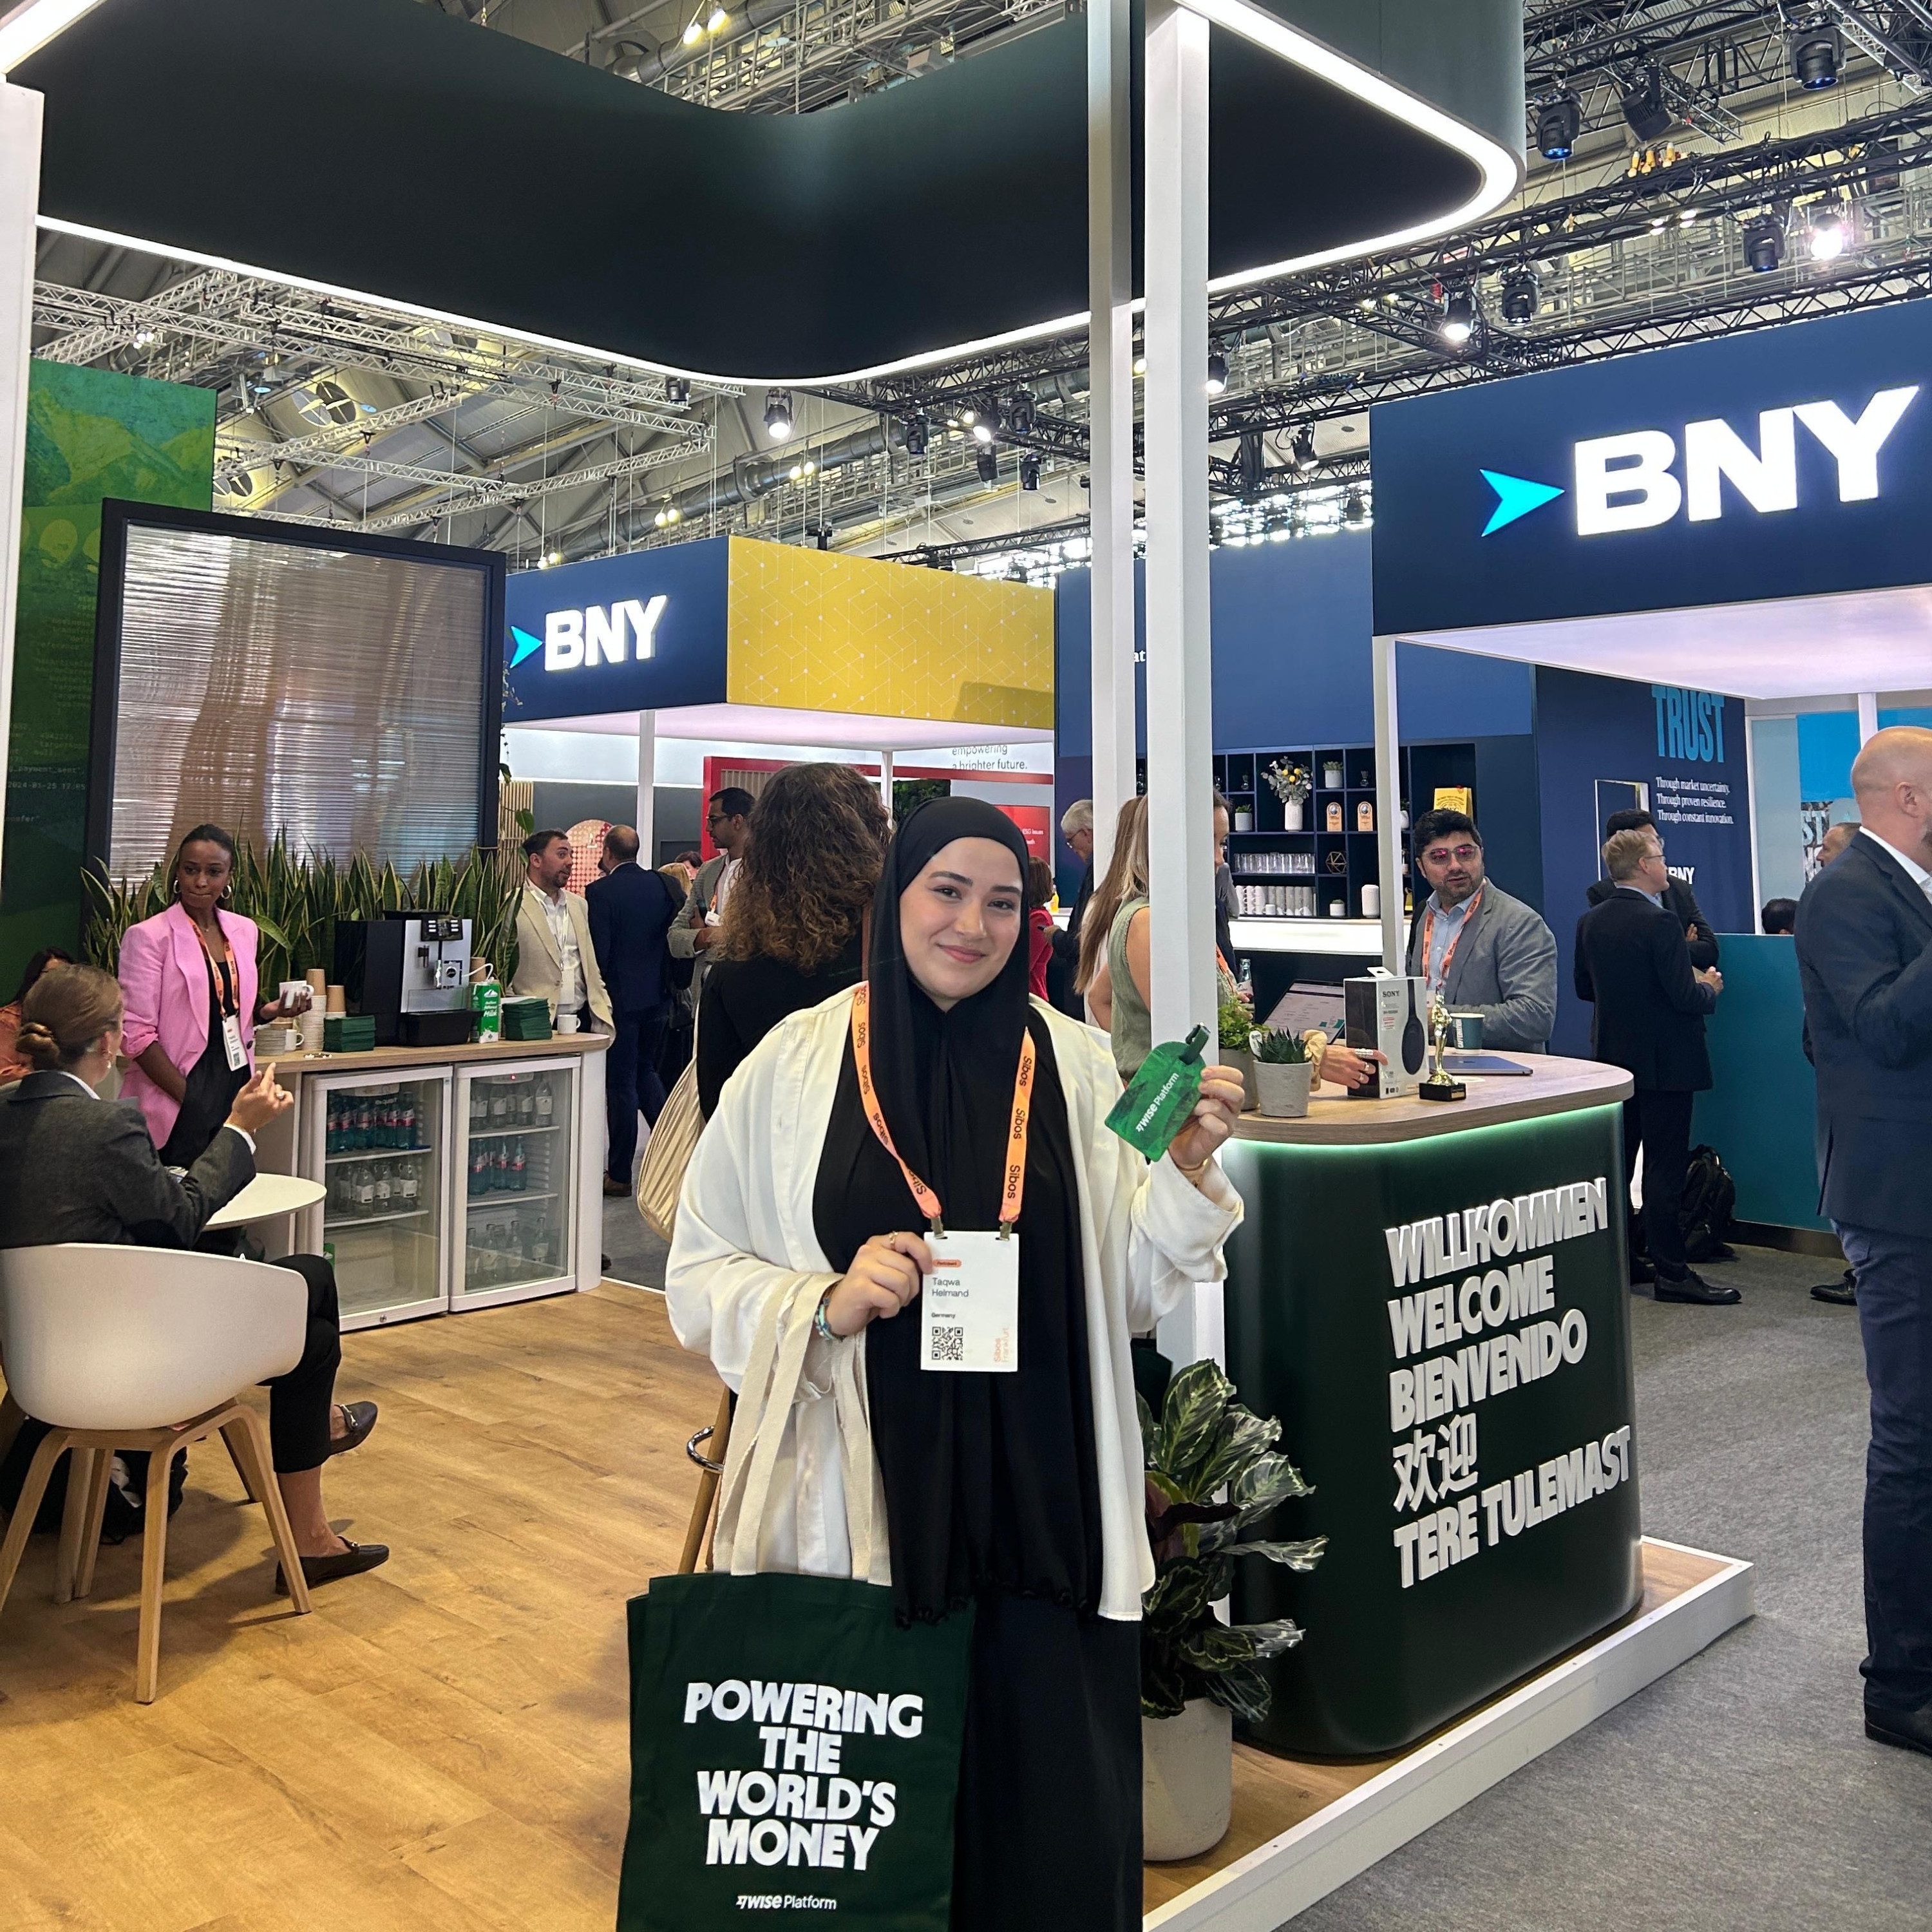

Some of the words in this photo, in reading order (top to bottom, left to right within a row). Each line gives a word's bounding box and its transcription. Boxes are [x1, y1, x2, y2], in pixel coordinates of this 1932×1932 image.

[1575, 385, 1919, 535] BNY
[545, 595, 667, 672] BNY
[1651, 685, 1725, 762] TRUST
[952, 745, 1008, 757] empowering
[998, 758, 1027, 770] future.
[1656, 777, 1680, 791] Through
[1681, 779, 1700, 791] market
[1700, 782, 1730, 795] uncertainty.
[1656, 793, 1680, 808] Through
[1681, 797, 1700, 808] proven
[1657, 810, 1681, 824] Through
[1682, 813, 1705, 823] constant
[1705, 812, 1734, 824] innovation.
[1668, 867, 1694, 885] BNY
[857, 1022, 866, 1048] Sibos
[1019, 1056, 1032, 1086] Sibos
[1153, 1072, 1179, 1106] Platform
[873, 1113, 889, 1146] Sibos
[1014, 1108, 1026, 1139] Sibos
[1008, 1164, 1021, 1199] Sibos
[1385, 1177, 1607, 1287] WILLKOMMEN
[932, 1277, 960, 1287] Taqwa
[932, 1289, 969, 1298] Helmand
[1388, 1255, 1555, 1358] WELCOME
[1389, 1309, 1587, 1432] BIENVENIDO
[1393, 1413, 1479, 1512] 欢迎
[1394, 1494, 1479, 1588] TERE
[1481, 1425, 1631, 1547] TULEMAST
[683, 1679, 923, 1739] POWERING
[759, 1726, 842, 1774] THE
[697, 1770, 896, 1828] WORLD'S
[706, 1819, 880, 1871] MONEY
[784, 1895, 837, 1910] Platform
